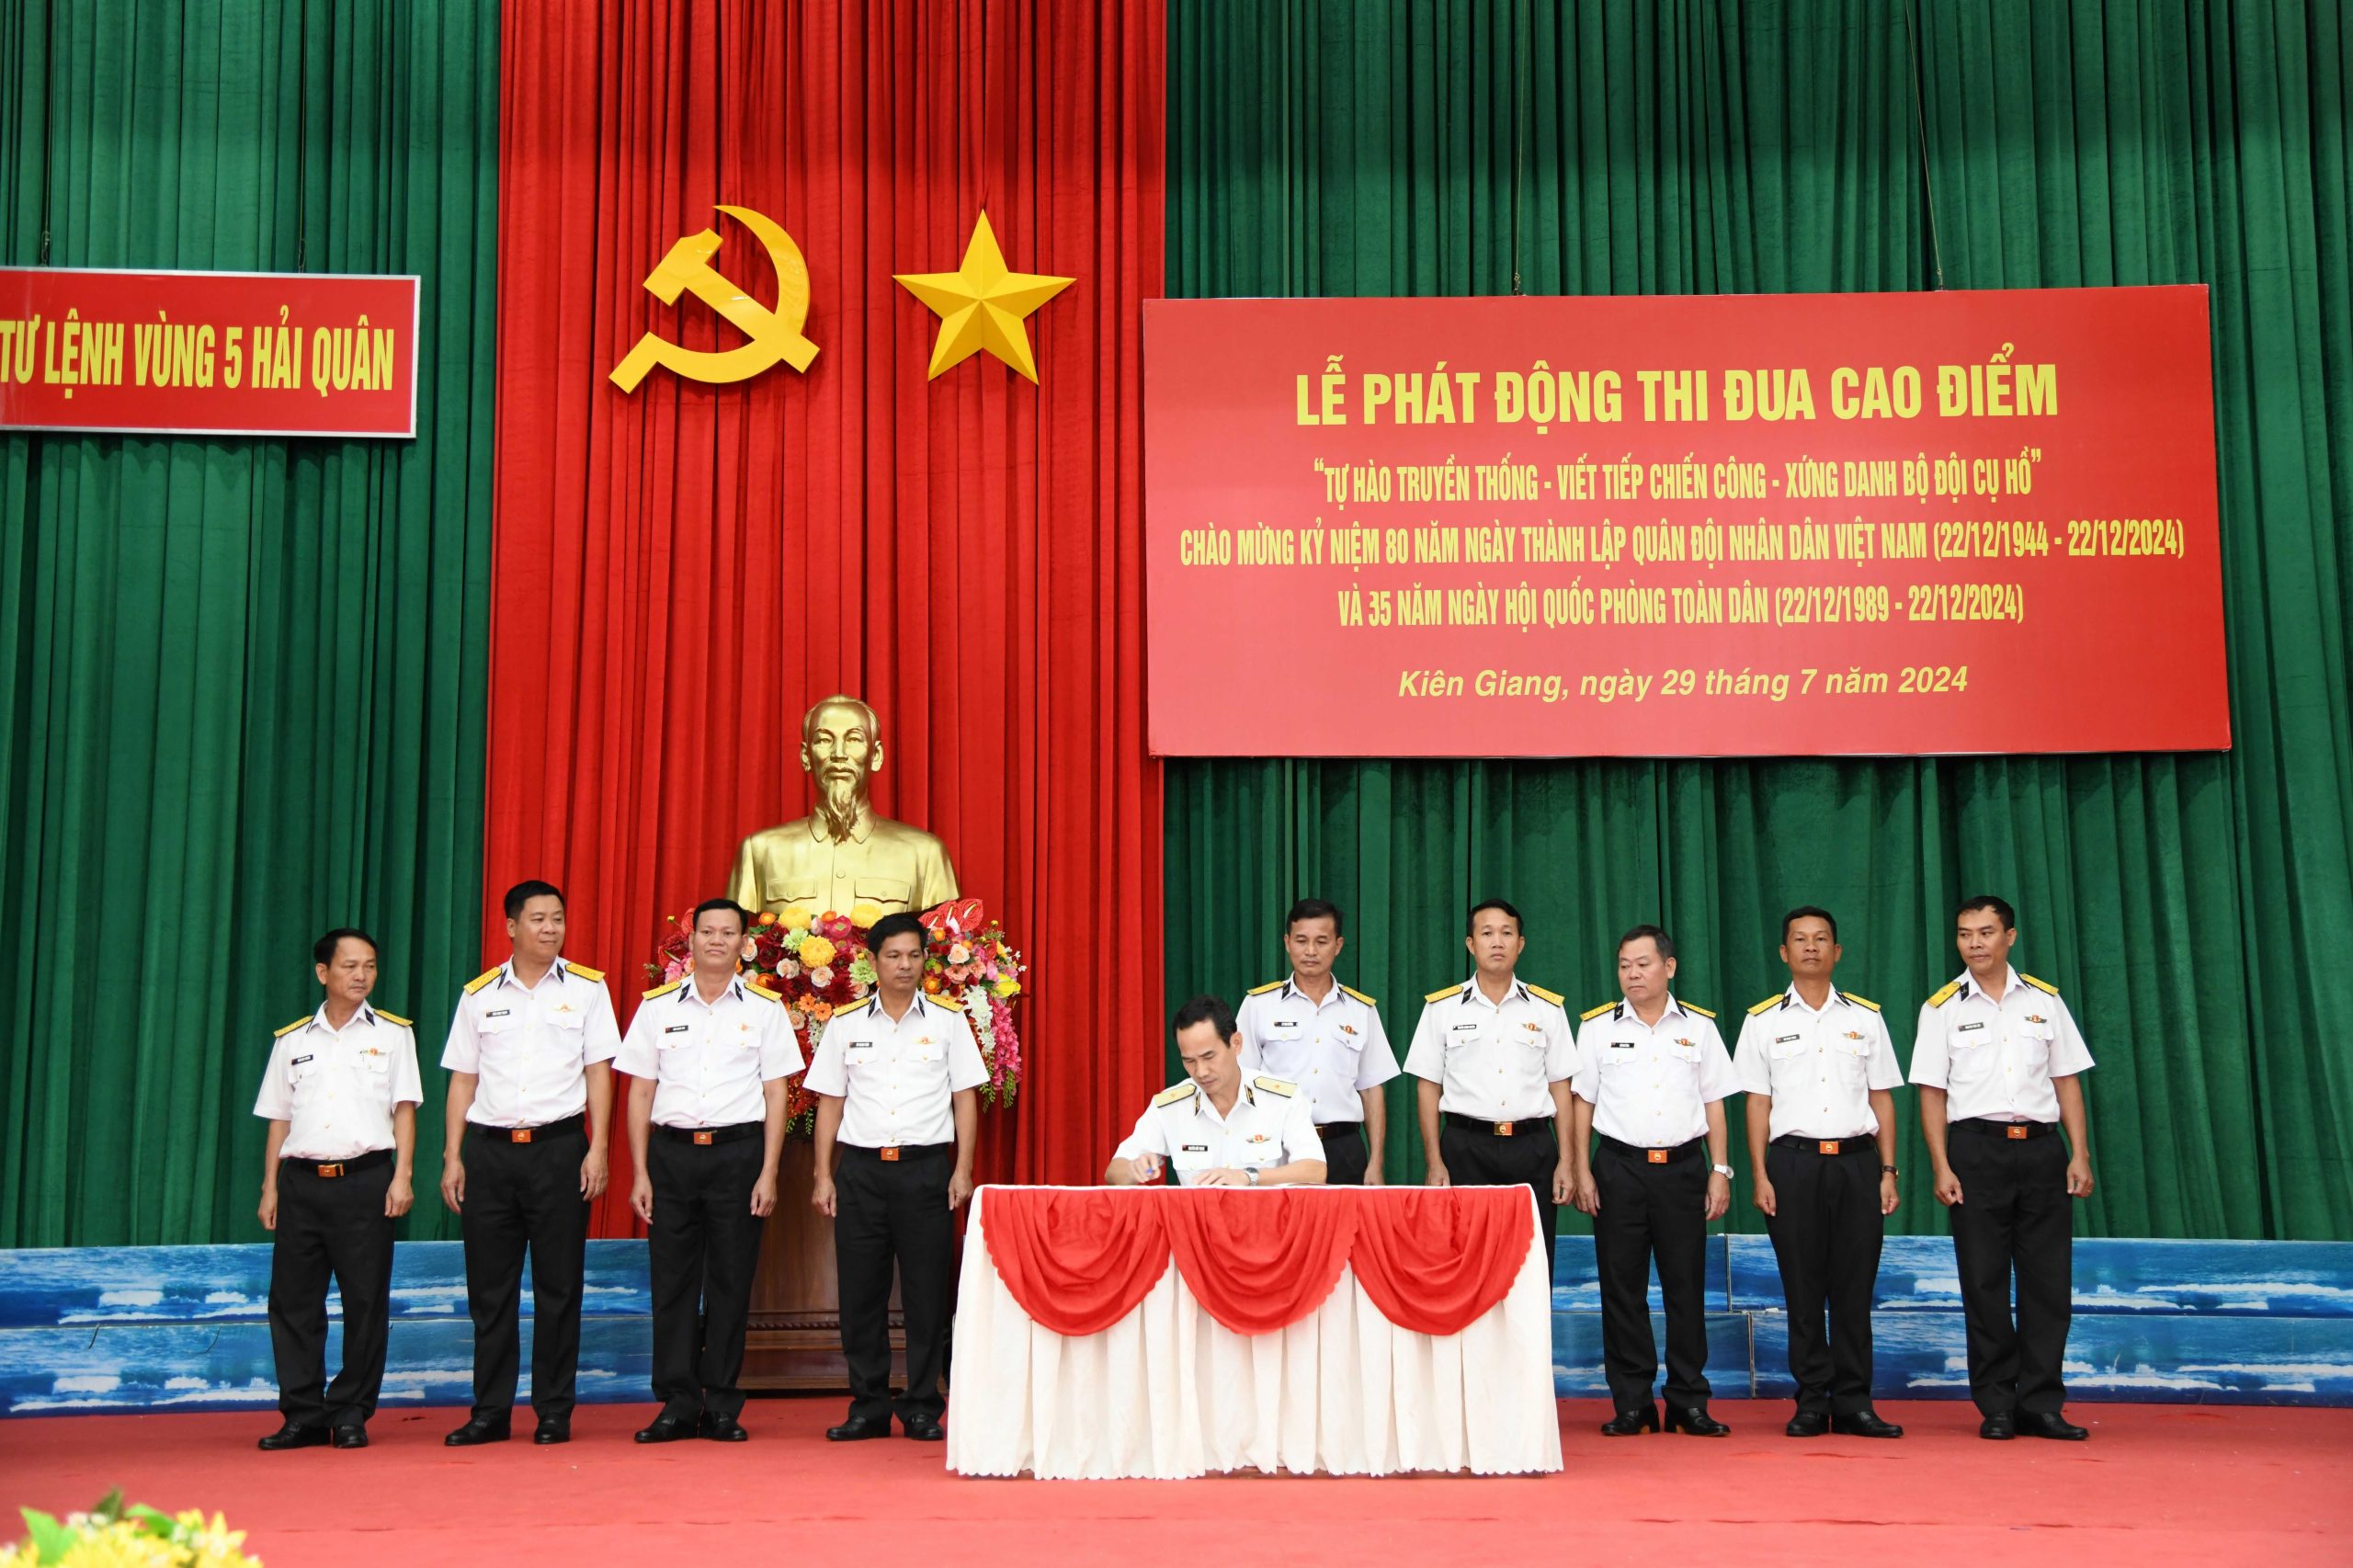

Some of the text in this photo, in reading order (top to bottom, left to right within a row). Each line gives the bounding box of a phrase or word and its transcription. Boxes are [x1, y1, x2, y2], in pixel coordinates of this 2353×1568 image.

[0, 304, 393, 398] TƯ LỆNH VÙNG 5 HẢI QUÂN
[1297, 343, 2057, 435] LỄ PHÁT ĐỘNG THI ĐUA CAO ĐIỂM
[1353, 460, 1391, 503] HÀO
[1397, 454, 1470, 501] TRUYỀN
[1475, 452, 1538, 500] THỐNG
[1557, 453, 1597, 500] VIẾT
[1603, 452, 1643, 500] TIẾP
[1650, 451, 1708, 500] CHIẾN
[1713, 456, 1766, 499] CÔNG
[1786, 454, 1838, 498] XỨNG
[1844, 460, 1897, 497] DANH
[1903, 452, 1928, 504] BỘ
[1935, 451, 1967, 503] ĐỘI
[1973, 459, 1999, 503] CỤ
[1181, 522, 1231, 565] CHÀO
[1237, 521, 1294, 565] MỪNG
[1301, 517, 1324, 564] KỶ
[1330, 521, 1380, 573] NIỆM
[1386, 529, 1409, 564] 80
[1415, 521, 1459, 563] NĂM
[1465, 520, 1516, 563] NGÀY
[1522, 520, 1585, 562] THÀNH
[1591, 518, 1626, 570] LẬP
[1633, 518, 1686, 565] QUÂN
[1691, 518, 1723, 569] ĐỘI
[1729, 517, 1783, 560] NHÂN
[1790, 517, 1829, 560] DÂN
[1835, 516, 1875, 567] VIỆT
[1881, 522, 1927, 559] NAM
[1934, 521, 2049, 561] (22/12/1944
[2068, 519, 2184, 559] 22/12/2024)
[1338, 583, 1362, 626] VÀ
[1369, 591, 1392, 626] 35
[1397, 583, 1442, 625] NĂM
[1448, 583, 1499, 625] NGÀY
[1506, 581, 1537, 632] HỘI
[1544, 575, 1594, 628] QUỐC
[1601, 579, 1666, 624] PHÒNG
[1671, 580, 1722, 623] TOÀN
[1729, 580, 1768, 623] DÂN
[1776, 585, 1889, 627] (22/12/1989
[1908, 584, 2023, 623] 22/12/2024)
[1399, 666, 1967, 702] Kiên Giang, ngày 29 tháng 7 năm 2024
